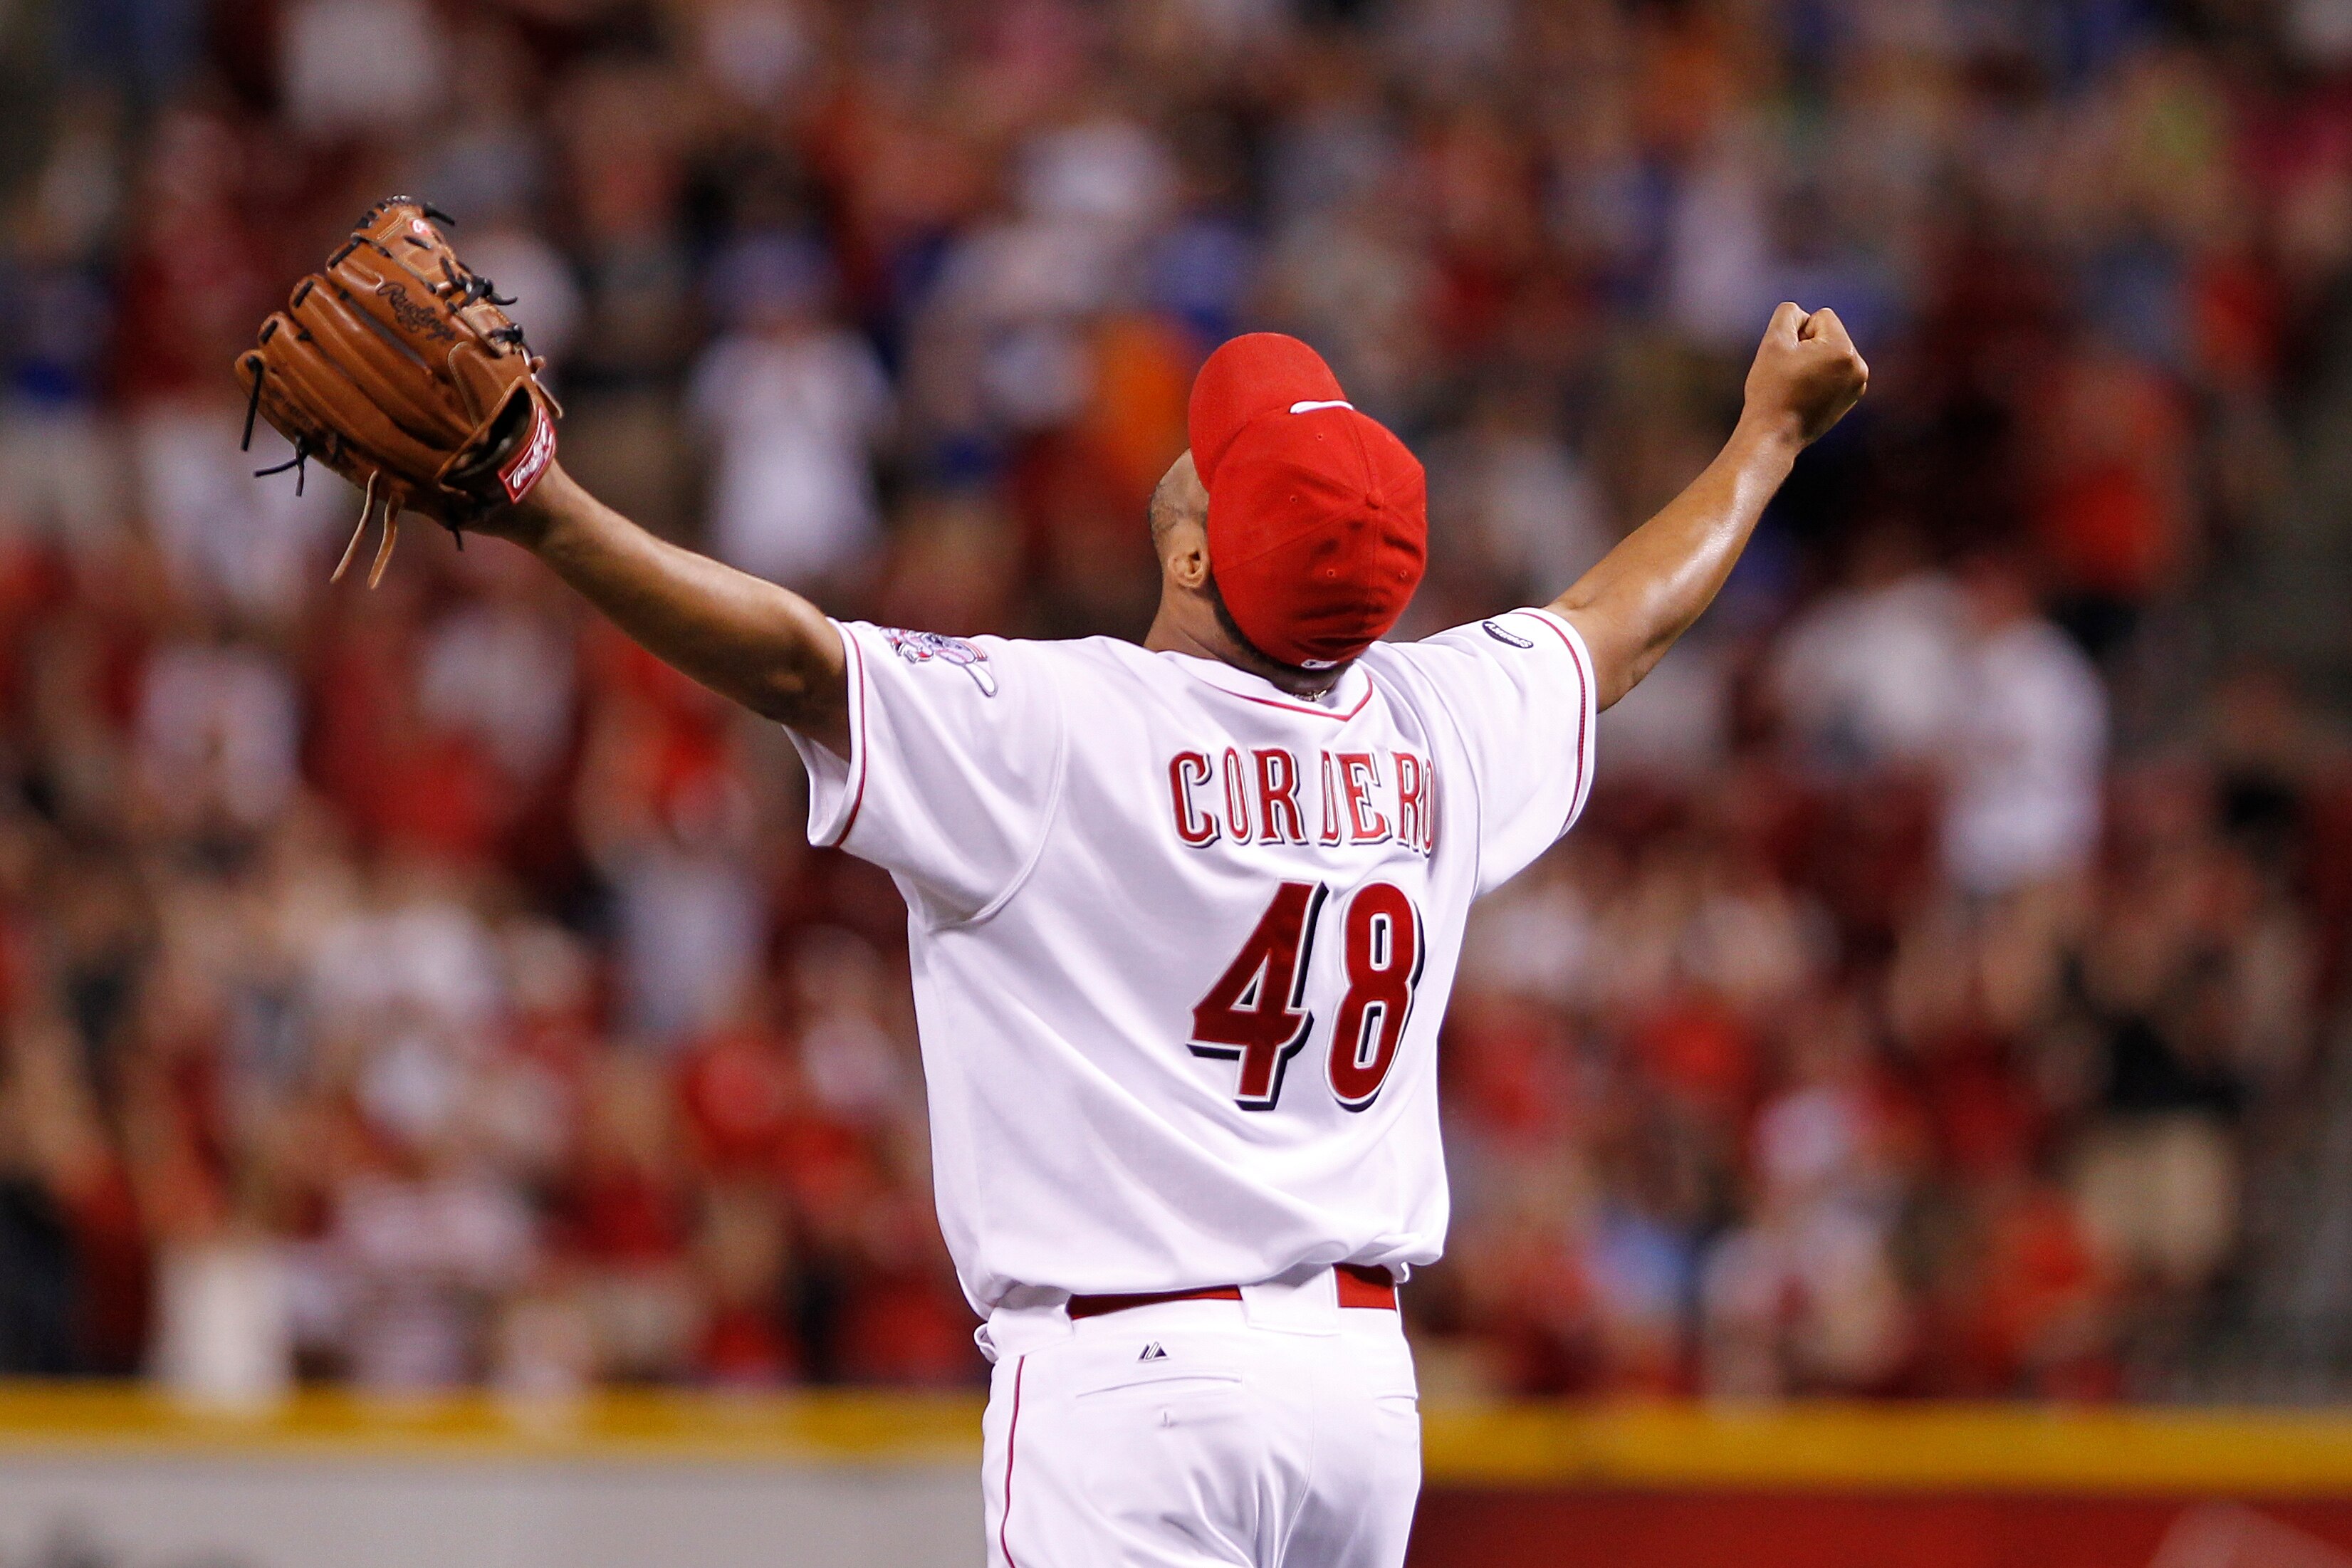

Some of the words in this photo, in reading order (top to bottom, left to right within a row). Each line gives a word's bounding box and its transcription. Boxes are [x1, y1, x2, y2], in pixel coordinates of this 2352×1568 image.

[377, 282, 455, 342] Rawlings
[1169, 746, 1436, 857] CORDERO
[1186, 879, 1426, 1113] 48
